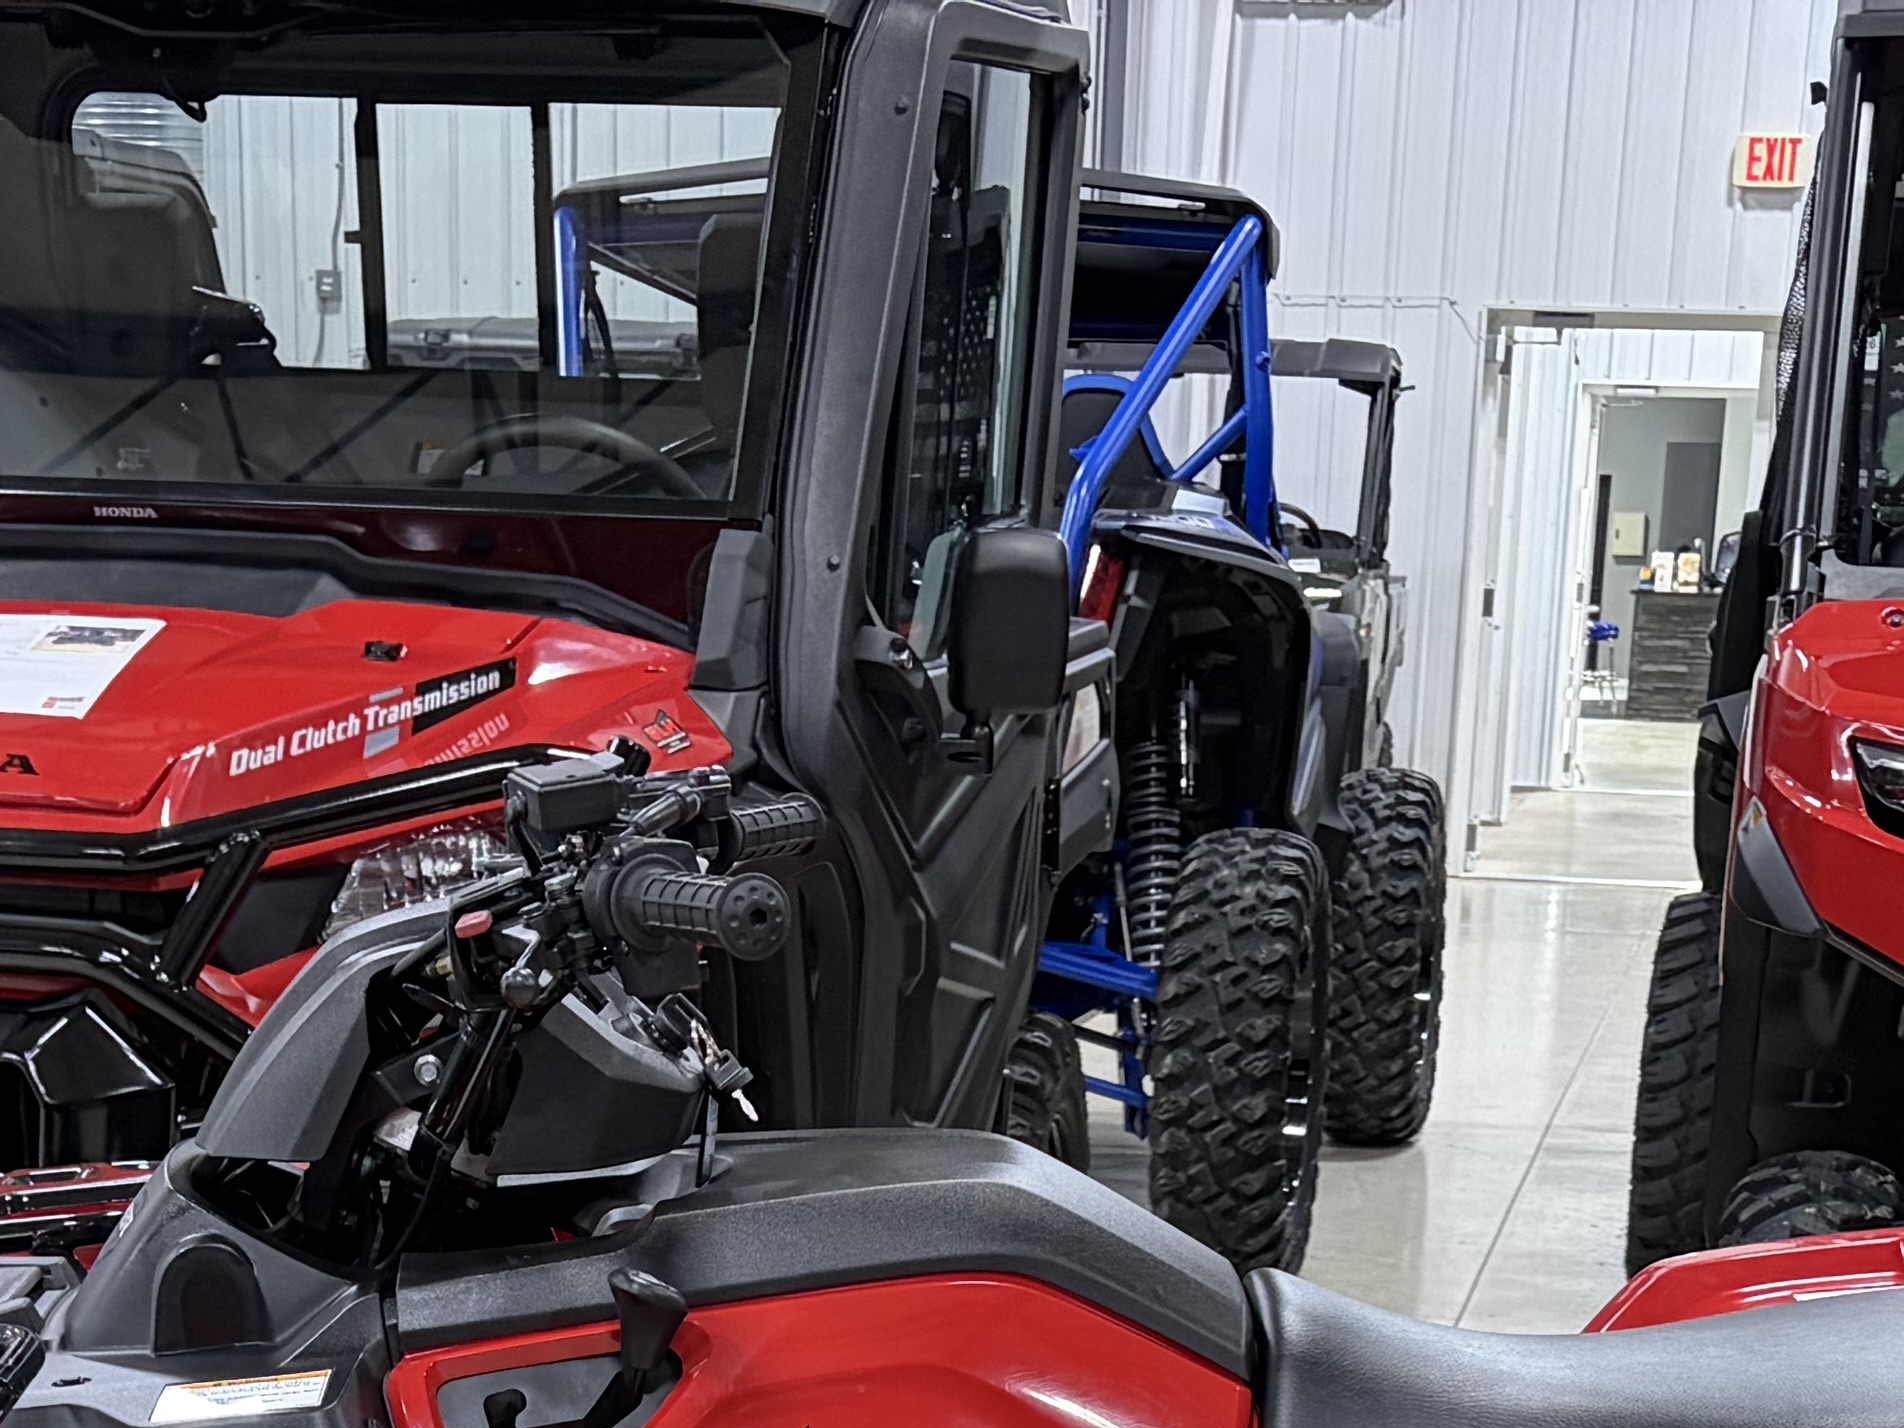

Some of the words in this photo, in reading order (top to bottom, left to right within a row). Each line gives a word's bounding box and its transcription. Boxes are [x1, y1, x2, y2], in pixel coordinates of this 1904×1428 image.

[1746, 137, 1803, 183] EXIT
[93, 506, 159, 519] HONDA
[229, 735, 286, 777] Dual
[290, 712, 361, 757] Clutch
[363, 670, 501, 731] Transmission
